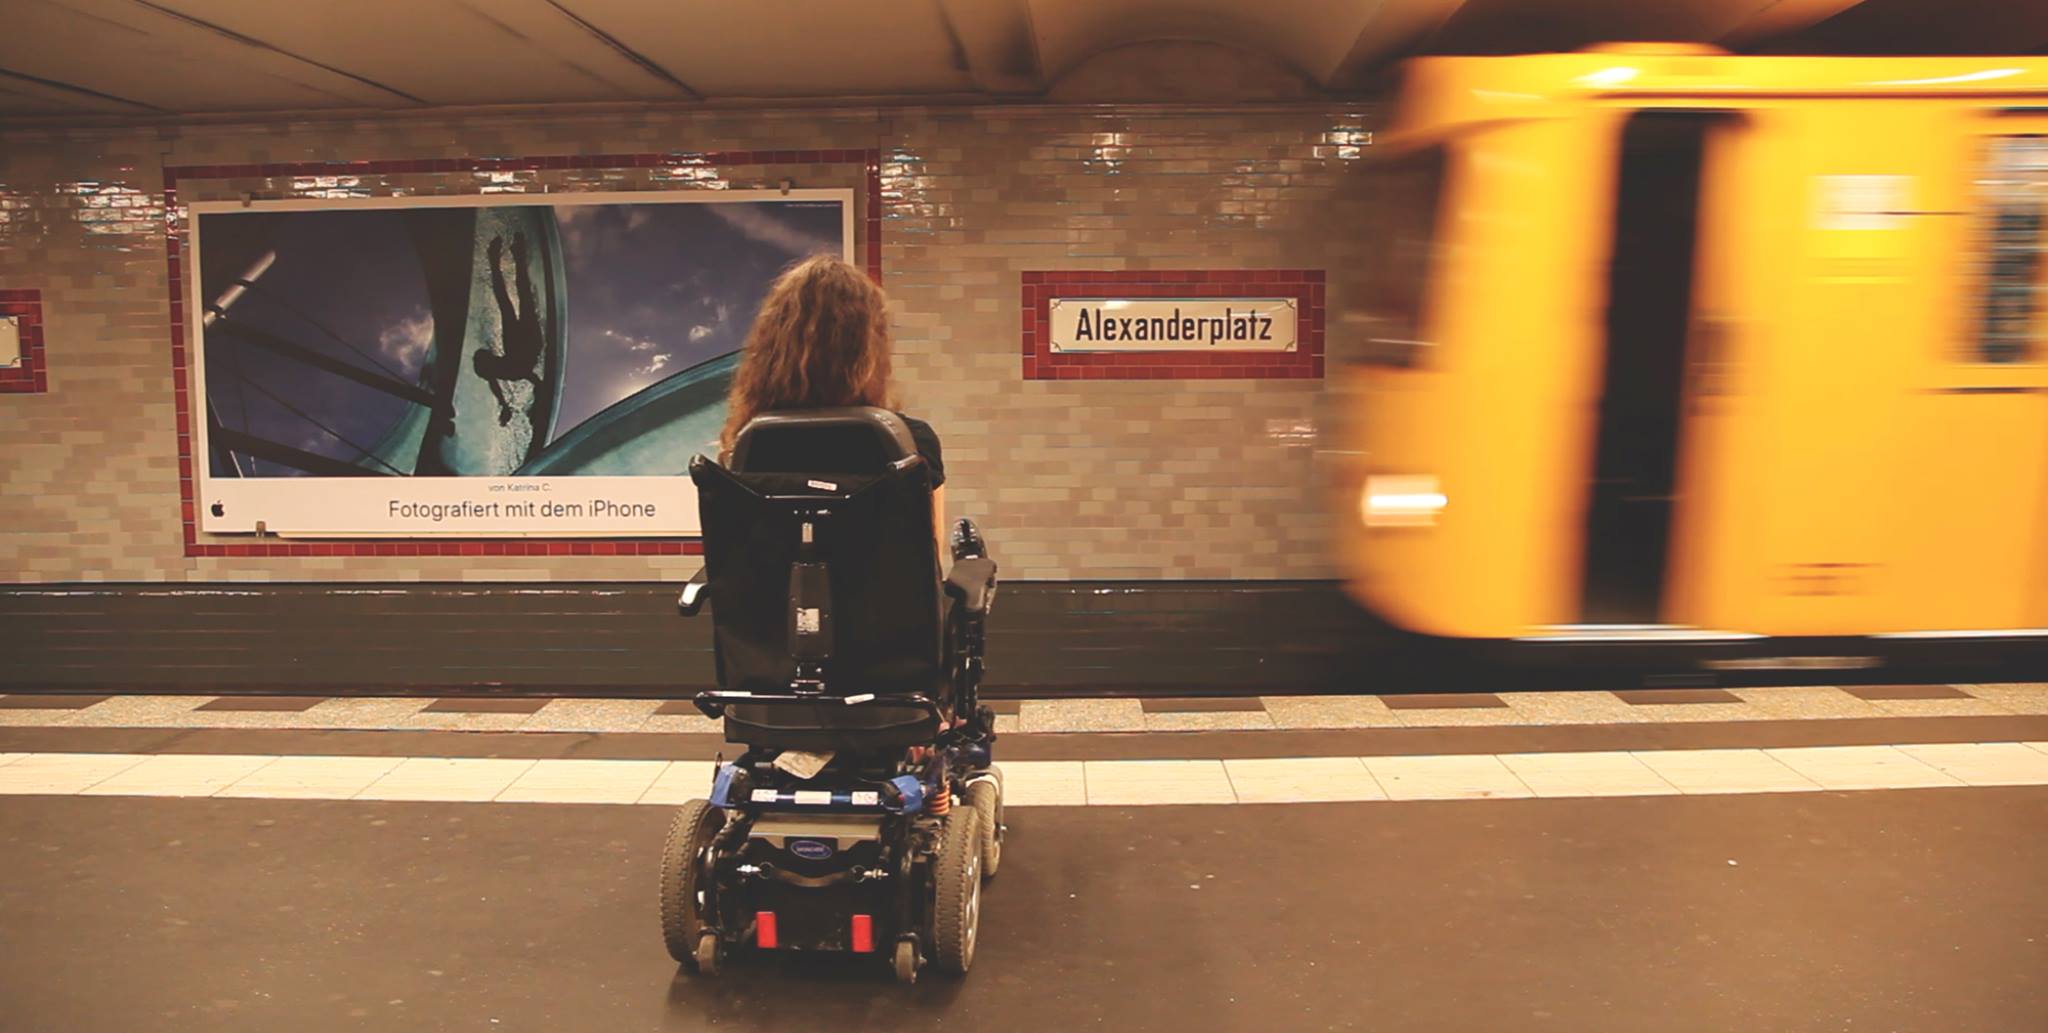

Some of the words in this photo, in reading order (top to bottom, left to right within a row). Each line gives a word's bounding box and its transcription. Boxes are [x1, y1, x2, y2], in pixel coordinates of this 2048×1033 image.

[1075, 307, 1272, 346] Alexanderplatz
[507, 483, 540, 492] Katrina
[388, 500, 499, 521] Fotografiert
[505, 501, 535, 518] mit
[540, 500, 583, 518] dem
[588, 500, 656, 518] iPhone
